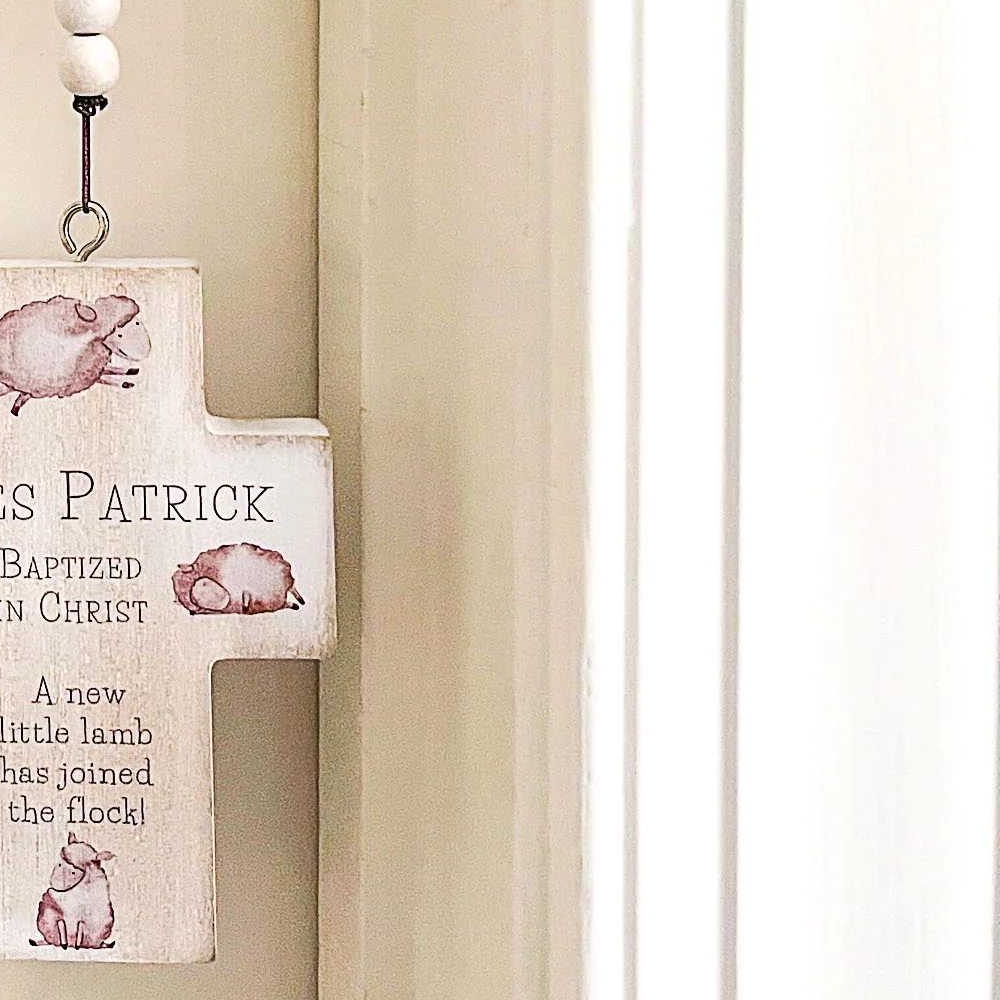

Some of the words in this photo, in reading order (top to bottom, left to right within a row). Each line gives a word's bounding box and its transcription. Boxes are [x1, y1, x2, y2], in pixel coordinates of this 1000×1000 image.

[60, 469, 275, 523] PATRICK
[0, 547, 142, 581] BAPTIZED
[39, 590, 149, 625] CHRIST
[31, 674, 56, 706] A
[65, 687, 127, 706] new
[79, 715, 153, 746] lamb
[0, 755, 49, 785] has
[57, 755, 155, 791] joined
[8, 794, 55, 824] the
[66, 795, 146, 827] flock!
